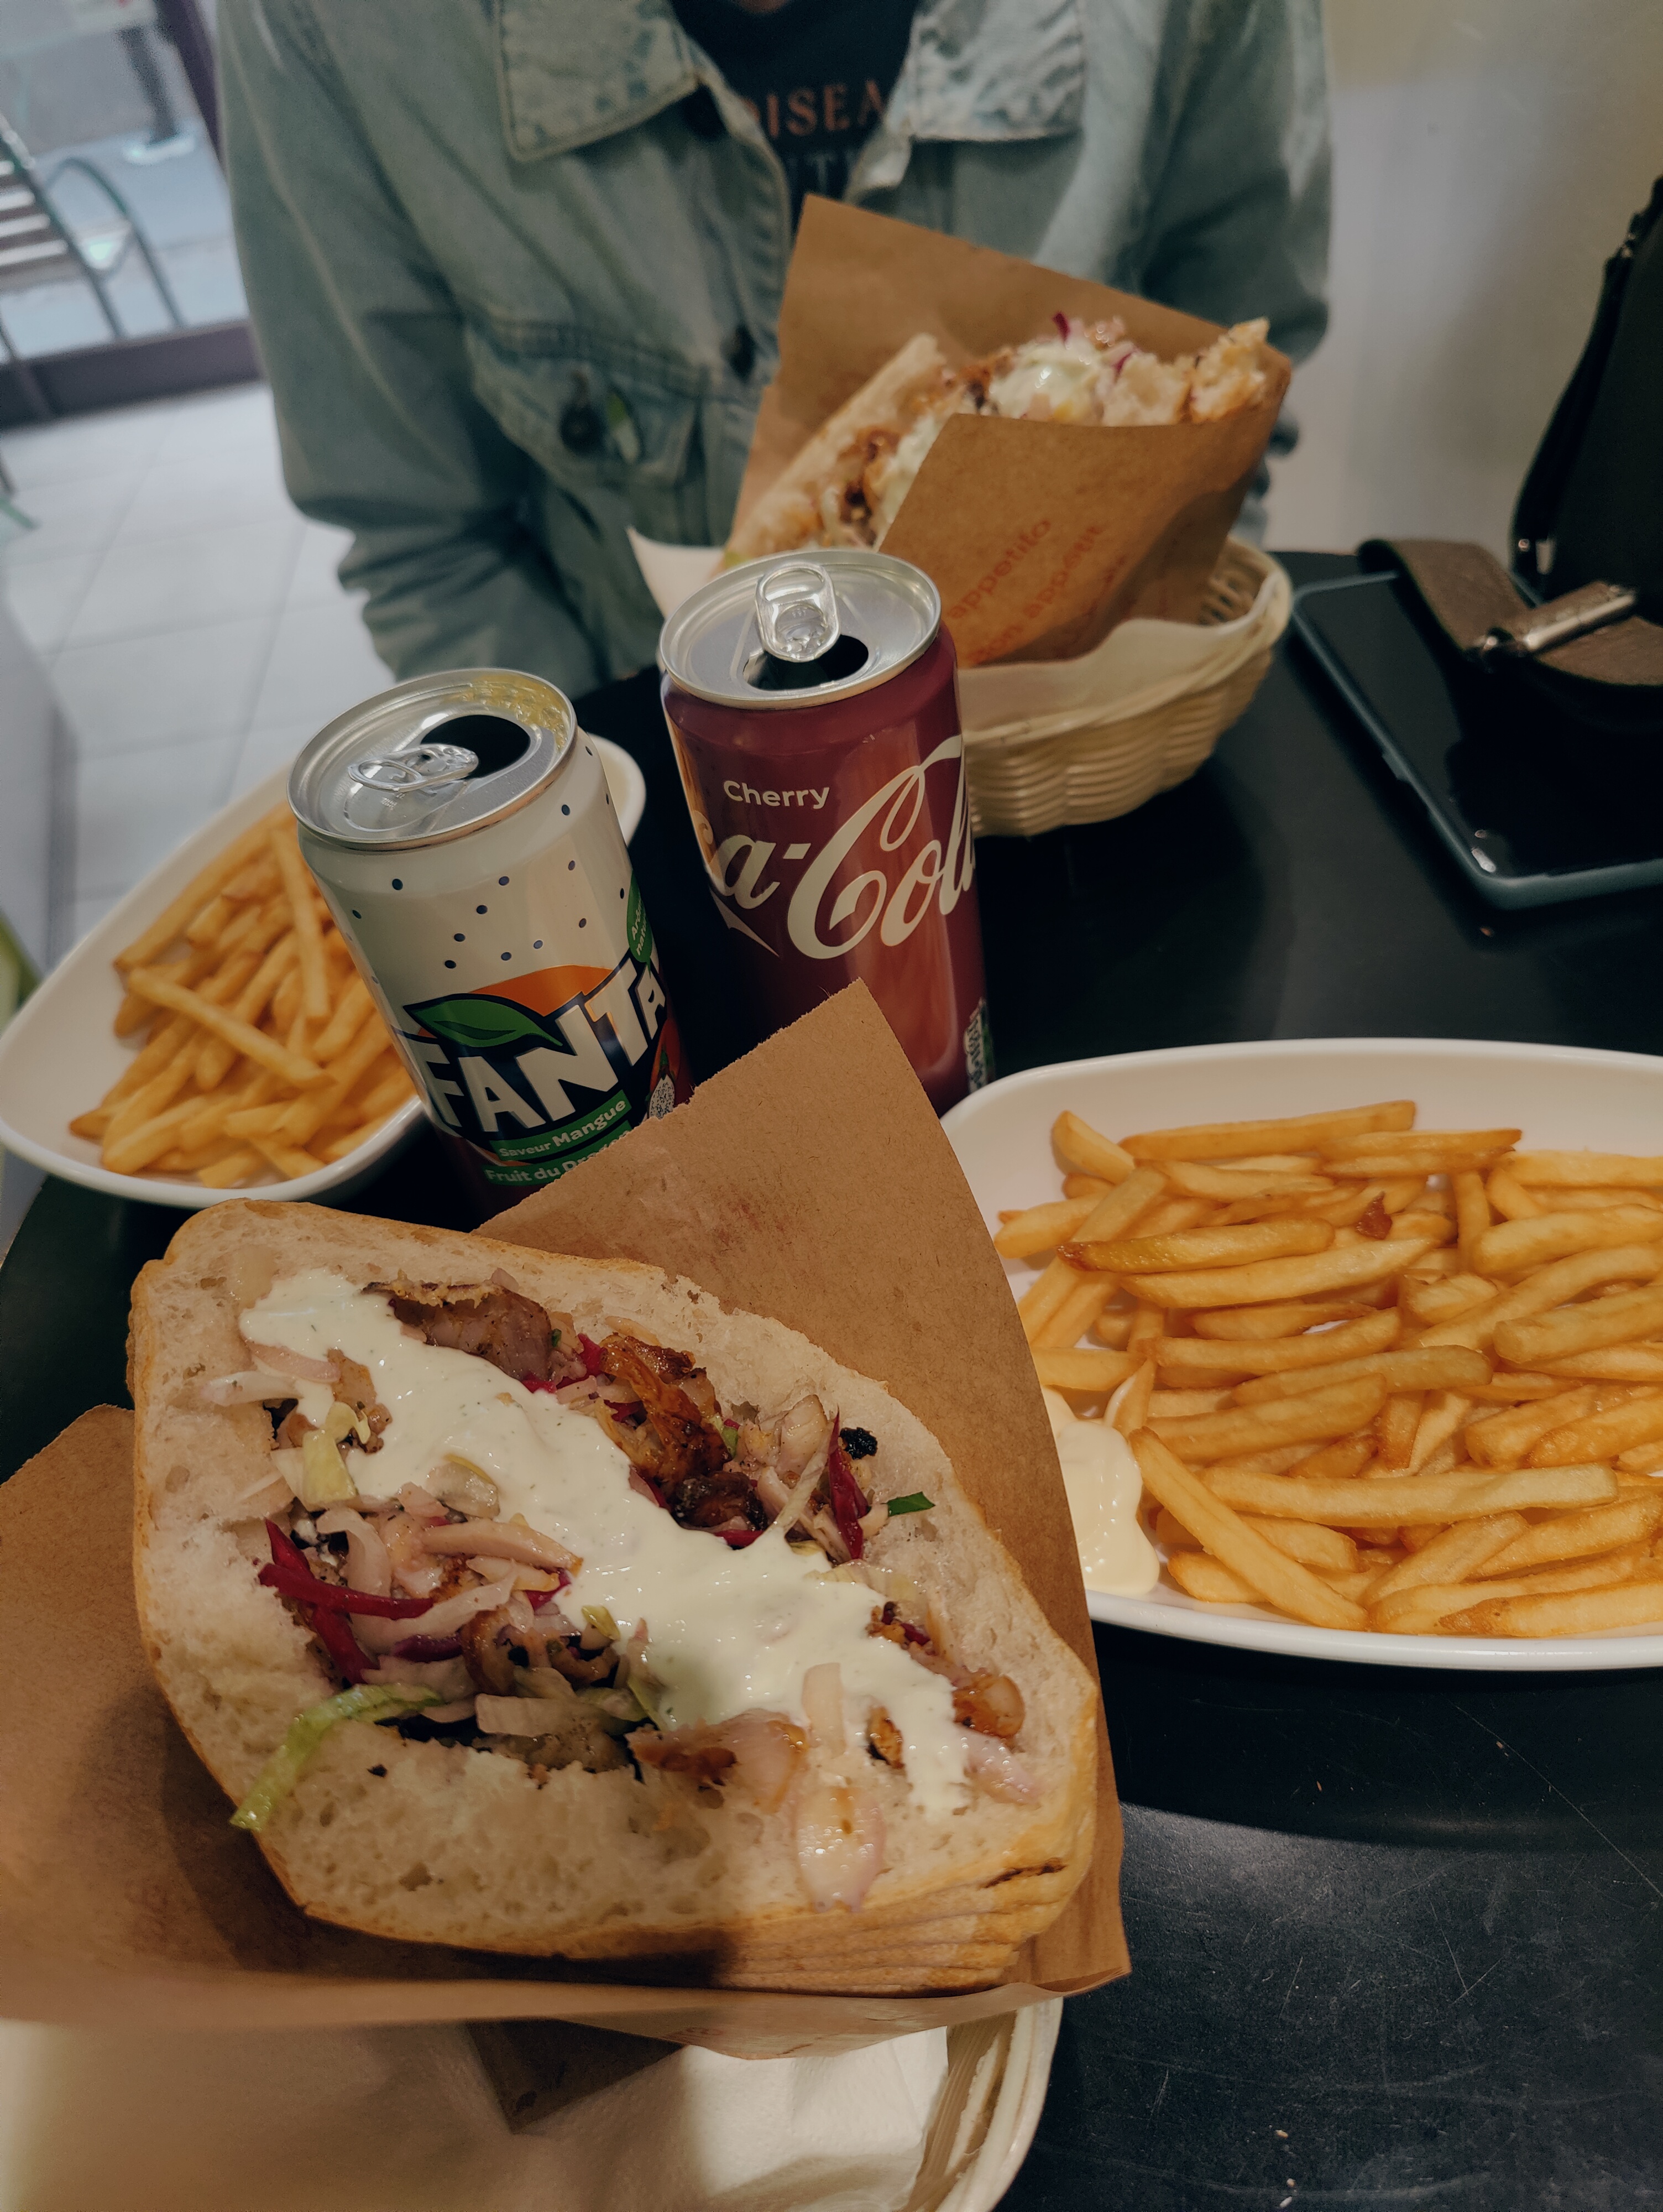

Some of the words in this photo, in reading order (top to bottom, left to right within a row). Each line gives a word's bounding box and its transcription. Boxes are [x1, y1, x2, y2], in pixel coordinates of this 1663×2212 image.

[723, 780, 830, 809] Cherry
[405, 958, 666, 1132] FANTA
[499, 1142, 552, 1157] Saveur
[552, 1100, 626, 1147] Mangue
[484, 1168, 532, 1182] Fruit
[534, 1167, 561, 1180] du
